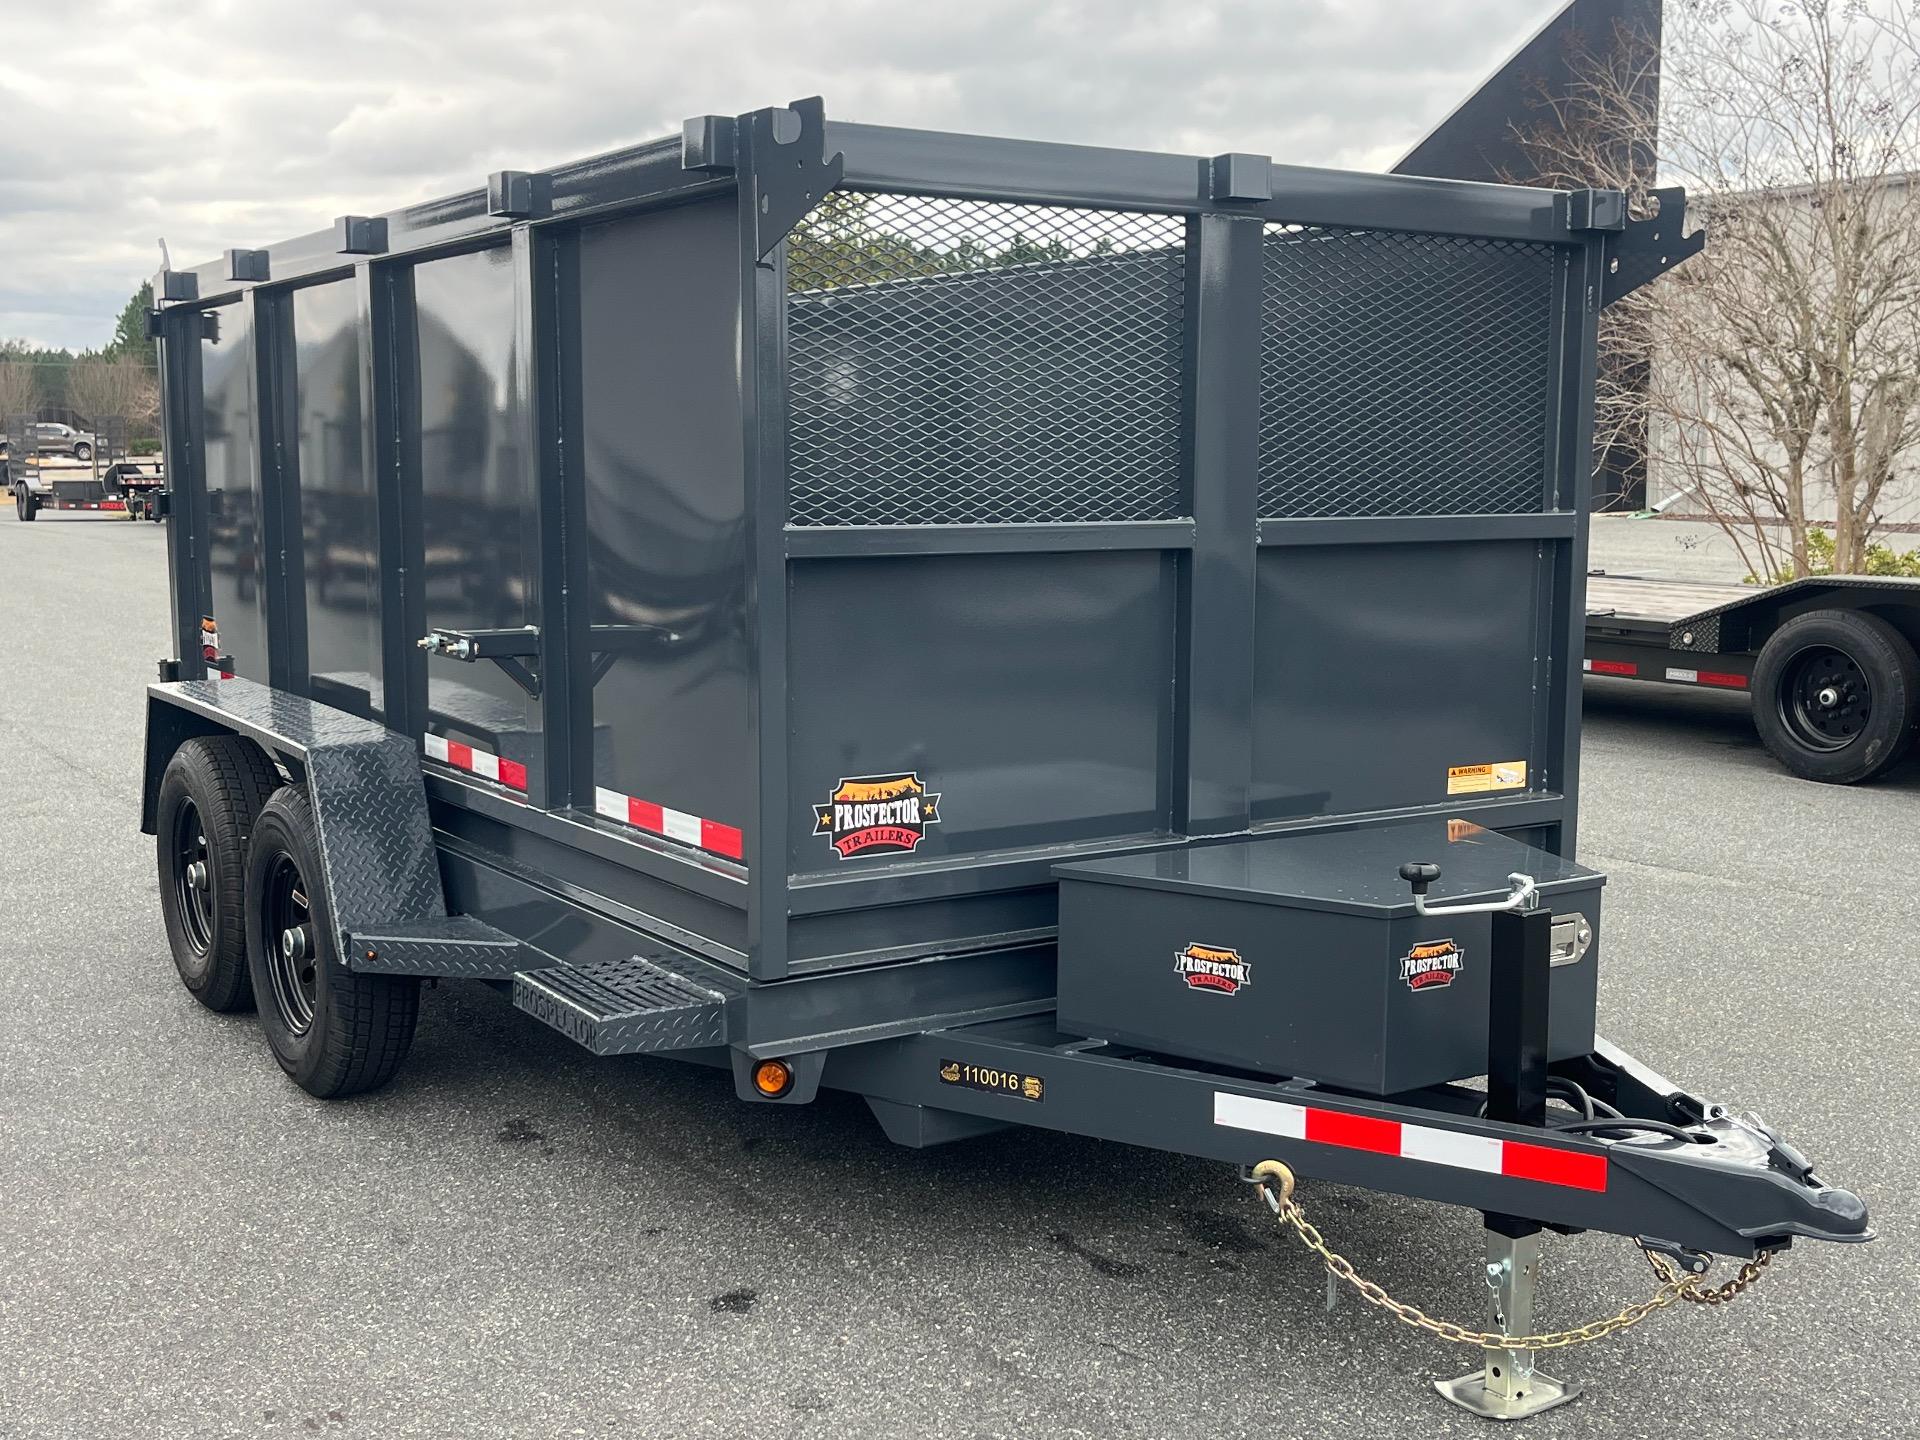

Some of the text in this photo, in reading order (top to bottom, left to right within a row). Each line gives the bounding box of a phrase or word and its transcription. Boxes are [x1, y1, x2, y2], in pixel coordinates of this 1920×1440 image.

[1458, 766, 1486, 775] WARNING
[834, 797, 921, 832] PROSPECTOR
[842, 830, 913, 851] TRAILERS
[1179, 955, 1245, 981] PROSPECTOR
[1403, 952, 1459, 977] PROSPECTOR
[1192, 976, 1232, 989] TRAILERS
[513, 981, 599, 1052] PROSPECTOR
[963, 1065, 1019, 1090] 110016
